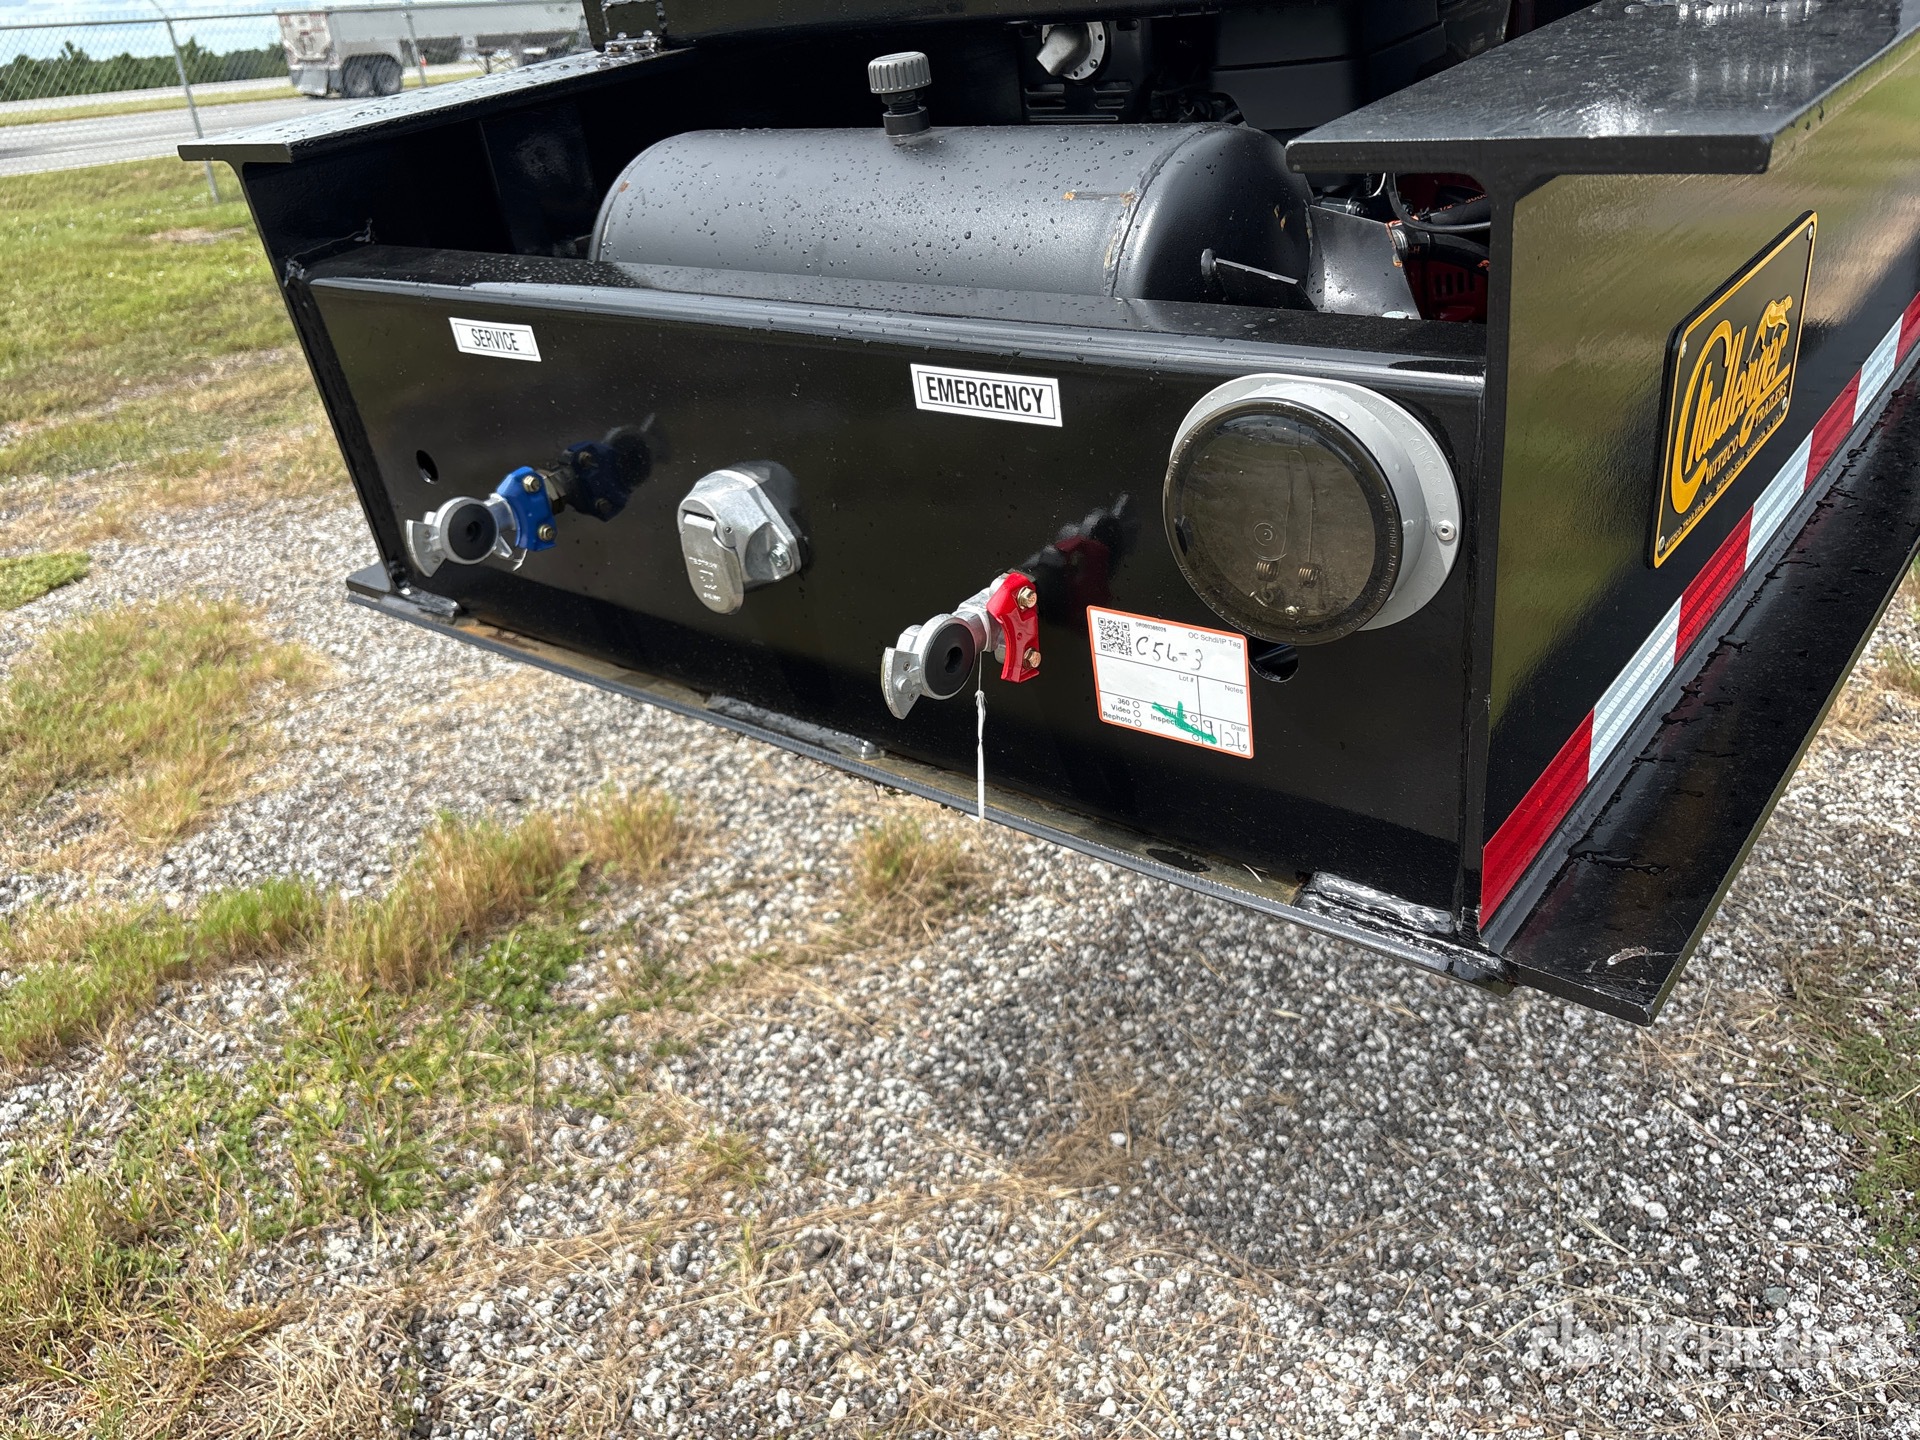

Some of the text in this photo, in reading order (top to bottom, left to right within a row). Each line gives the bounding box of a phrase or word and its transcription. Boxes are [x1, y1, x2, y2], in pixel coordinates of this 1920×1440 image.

[471, 328, 520, 351] SERVICE
[926, 376, 1043, 414] EMERGENCY
[1671, 320, 1791, 514] Challenger
[1705, 434, 1739, 486] WITZCO
[1754, 379, 1788, 428] TRAILERS
[1361, 396, 1407, 433] JAMES
[1408, 436, 1439, 473] KING
[1431, 476, 1441, 486] &
[1188, 631, 1199, 640] OC
[1228, 638, 1242, 649] Tag
[1178, 674, 1189, 682] Lot
[1224, 684, 1244, 694] Notes
[1117, 698, 1130, 706] 360
[1110, 704, 1131, 715] Video
[1165, 708, 1187, 719] Flus
[1103, 711, 1132, 724] Rephoto
[1231, 724, 1246, 733] Date
